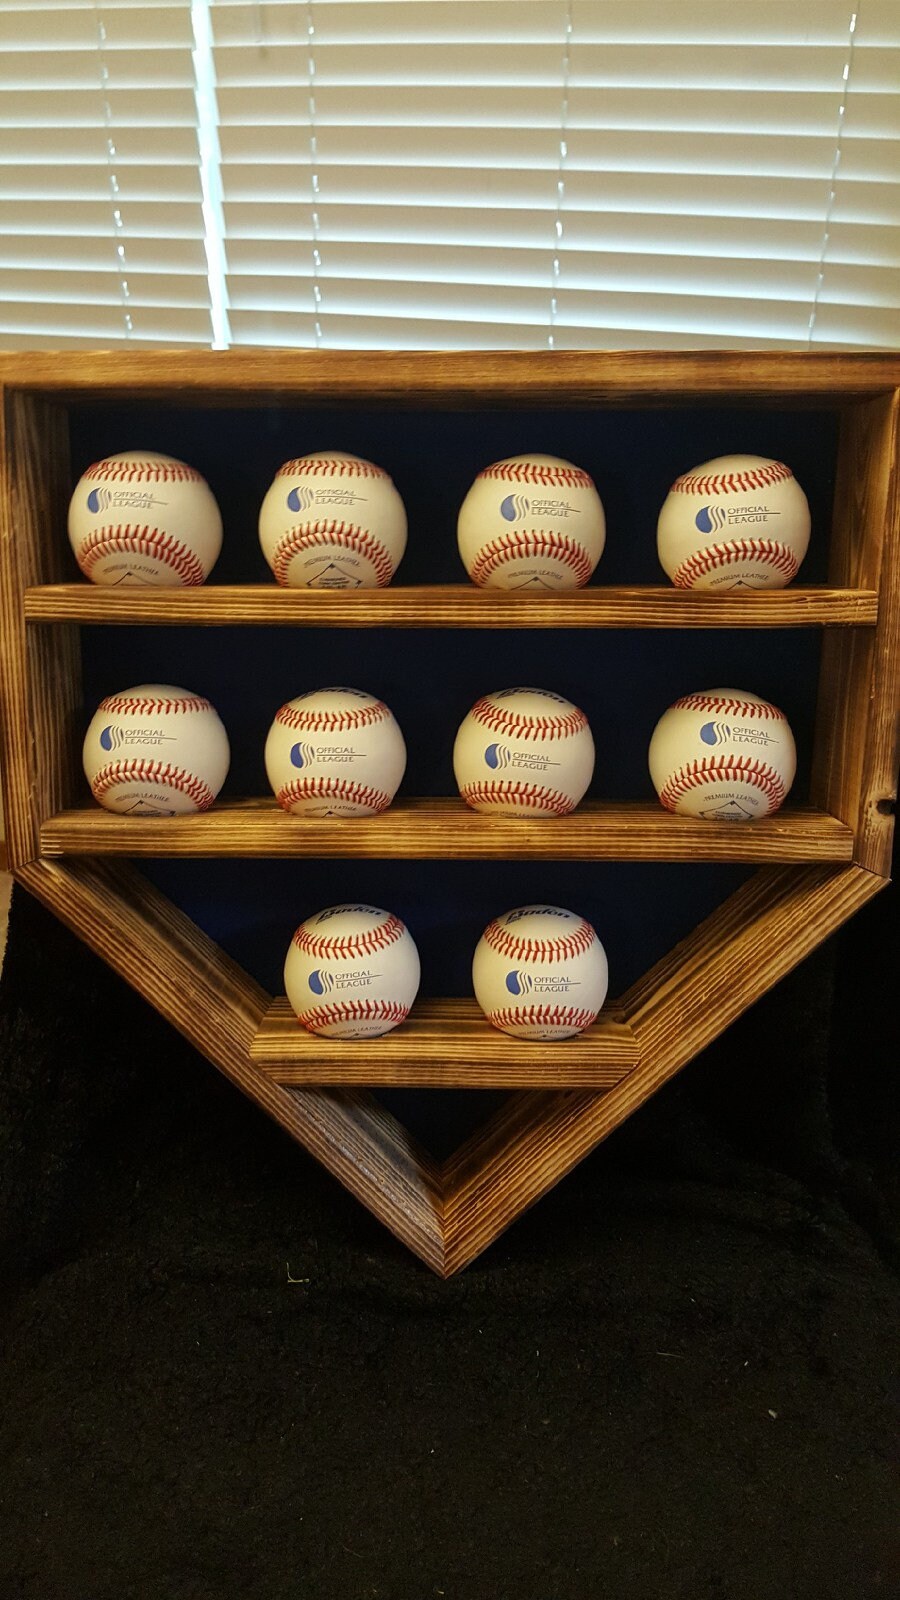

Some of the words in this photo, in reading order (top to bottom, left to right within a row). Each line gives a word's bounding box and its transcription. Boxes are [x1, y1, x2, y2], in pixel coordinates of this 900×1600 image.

[113, 491, 154, 500] OFFICIAL
[315, 488, 357, 498] OFFICIAL
[112, 499, 154, 511] LEAGUE
[315, 496, 357, 507] LEAGUE
[531, 499, 571, 509] OFFICIAL
[531, 507, 571, 519] LEAGUE
[727, 505, 770, 515] OFFICIAL
[728, 514, 769, 526] LEAGUE
[124, 729, 166, 738] OFFICIAL
[732, 726, 771, 739] OFFICIAL
[124, 737, 165, 747] LEAGUE
[732, 734, 770, 748] LEAGUE
[316, 746, 356, 755] OFFICIAL
[316, 755, 355, 764] LEAGUE
[512, 751, 552, 763] OFFICIAL
[511, 760, 550, 772] LEAGUE
[335, 970, 374, 981] OFFICIAL
[534, 975, 572, 984] OFFICIAL
[335, 978, 373, 990] LEAGUE
[534, 984, 571, 993] LEAGUE
